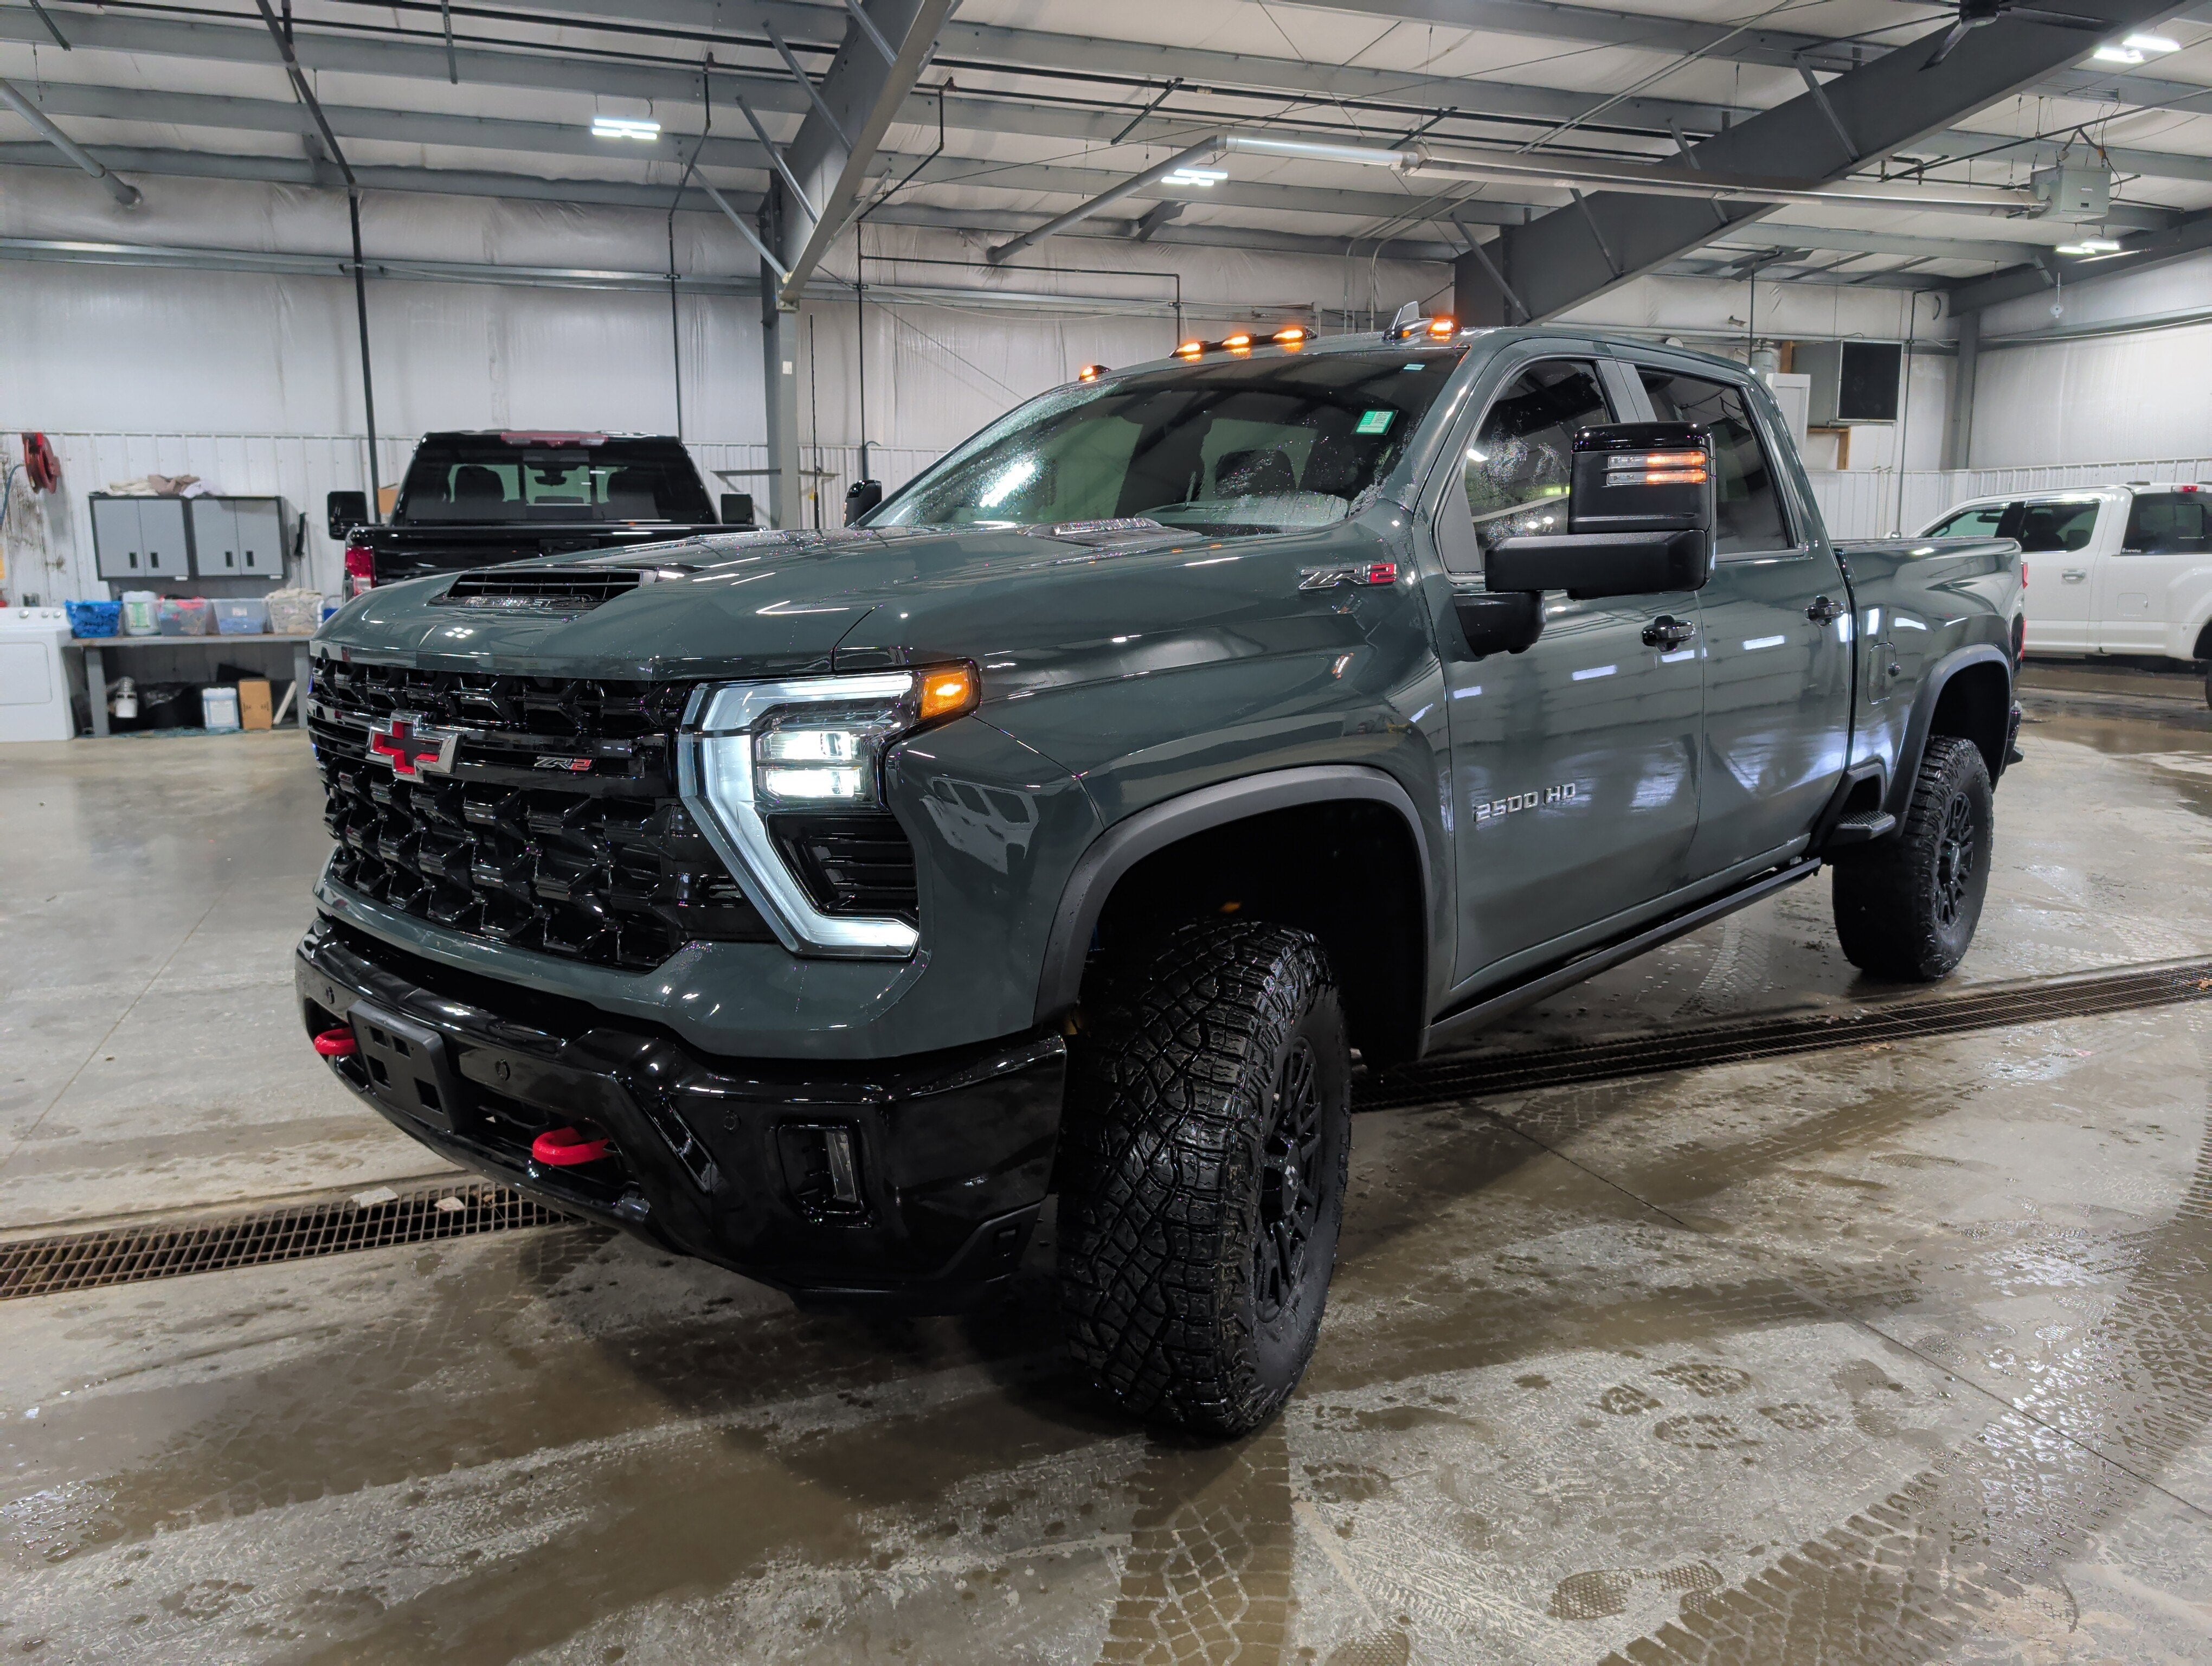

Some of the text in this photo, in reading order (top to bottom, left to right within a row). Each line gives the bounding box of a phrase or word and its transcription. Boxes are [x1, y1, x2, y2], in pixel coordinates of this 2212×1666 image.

[534, 756, 592, 771] ZR2
[1474, 783, 1576, 822] 2500 HD
